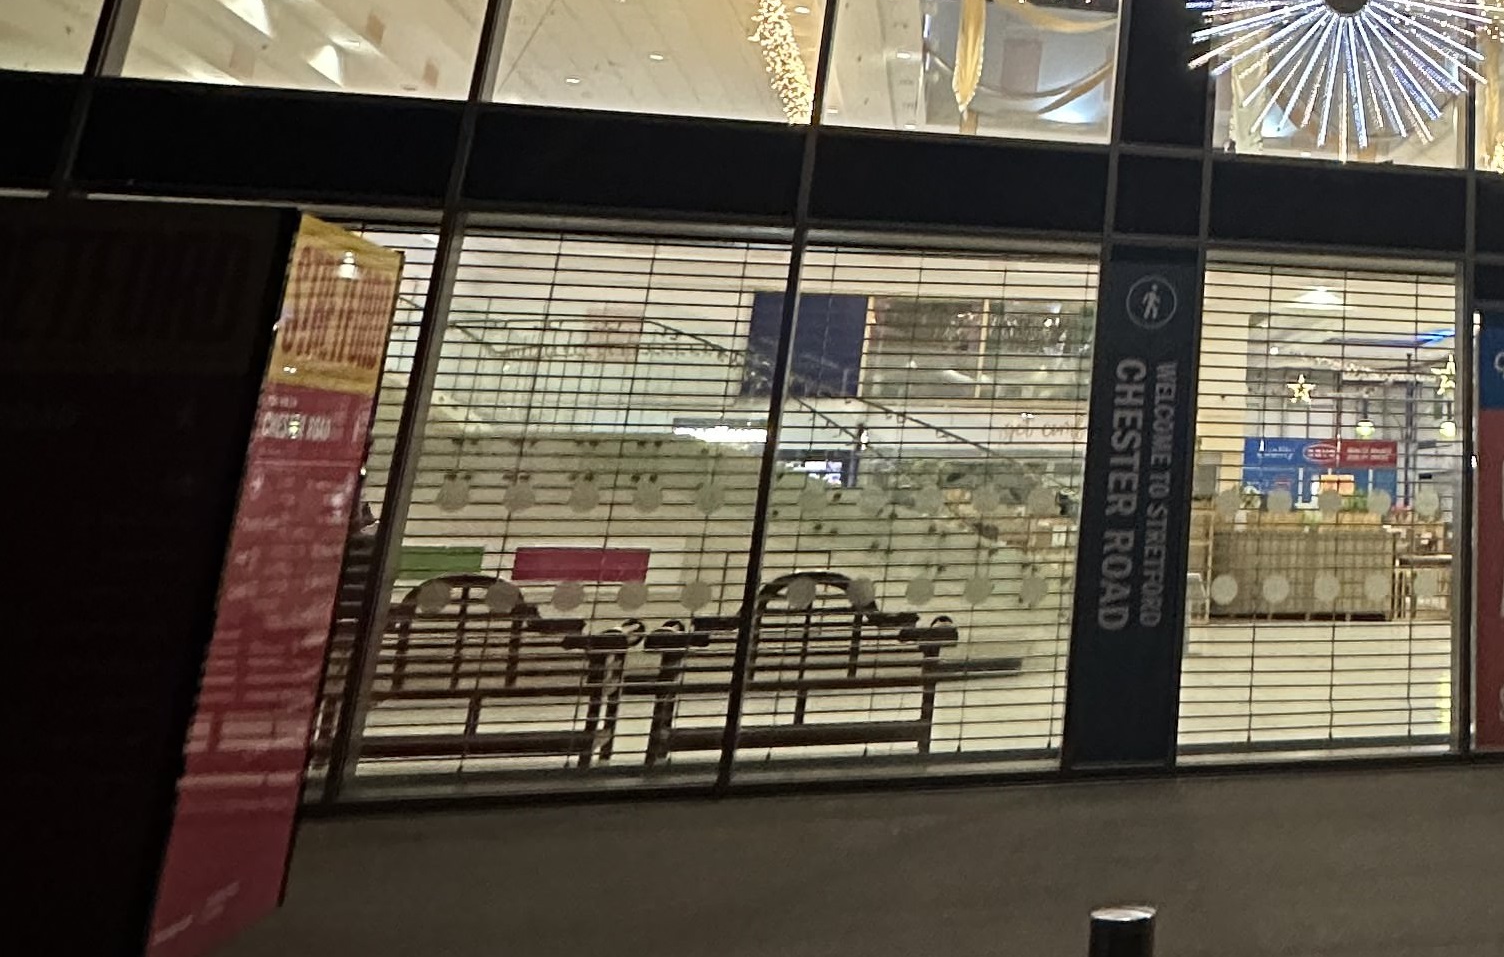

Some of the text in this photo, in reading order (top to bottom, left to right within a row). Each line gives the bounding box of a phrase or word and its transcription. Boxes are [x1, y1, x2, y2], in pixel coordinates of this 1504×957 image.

[1098, 359, 1148, 631] CHESTER ROAD
[1140, 362, 1179, 628] WELCOME TO STRETFORD
